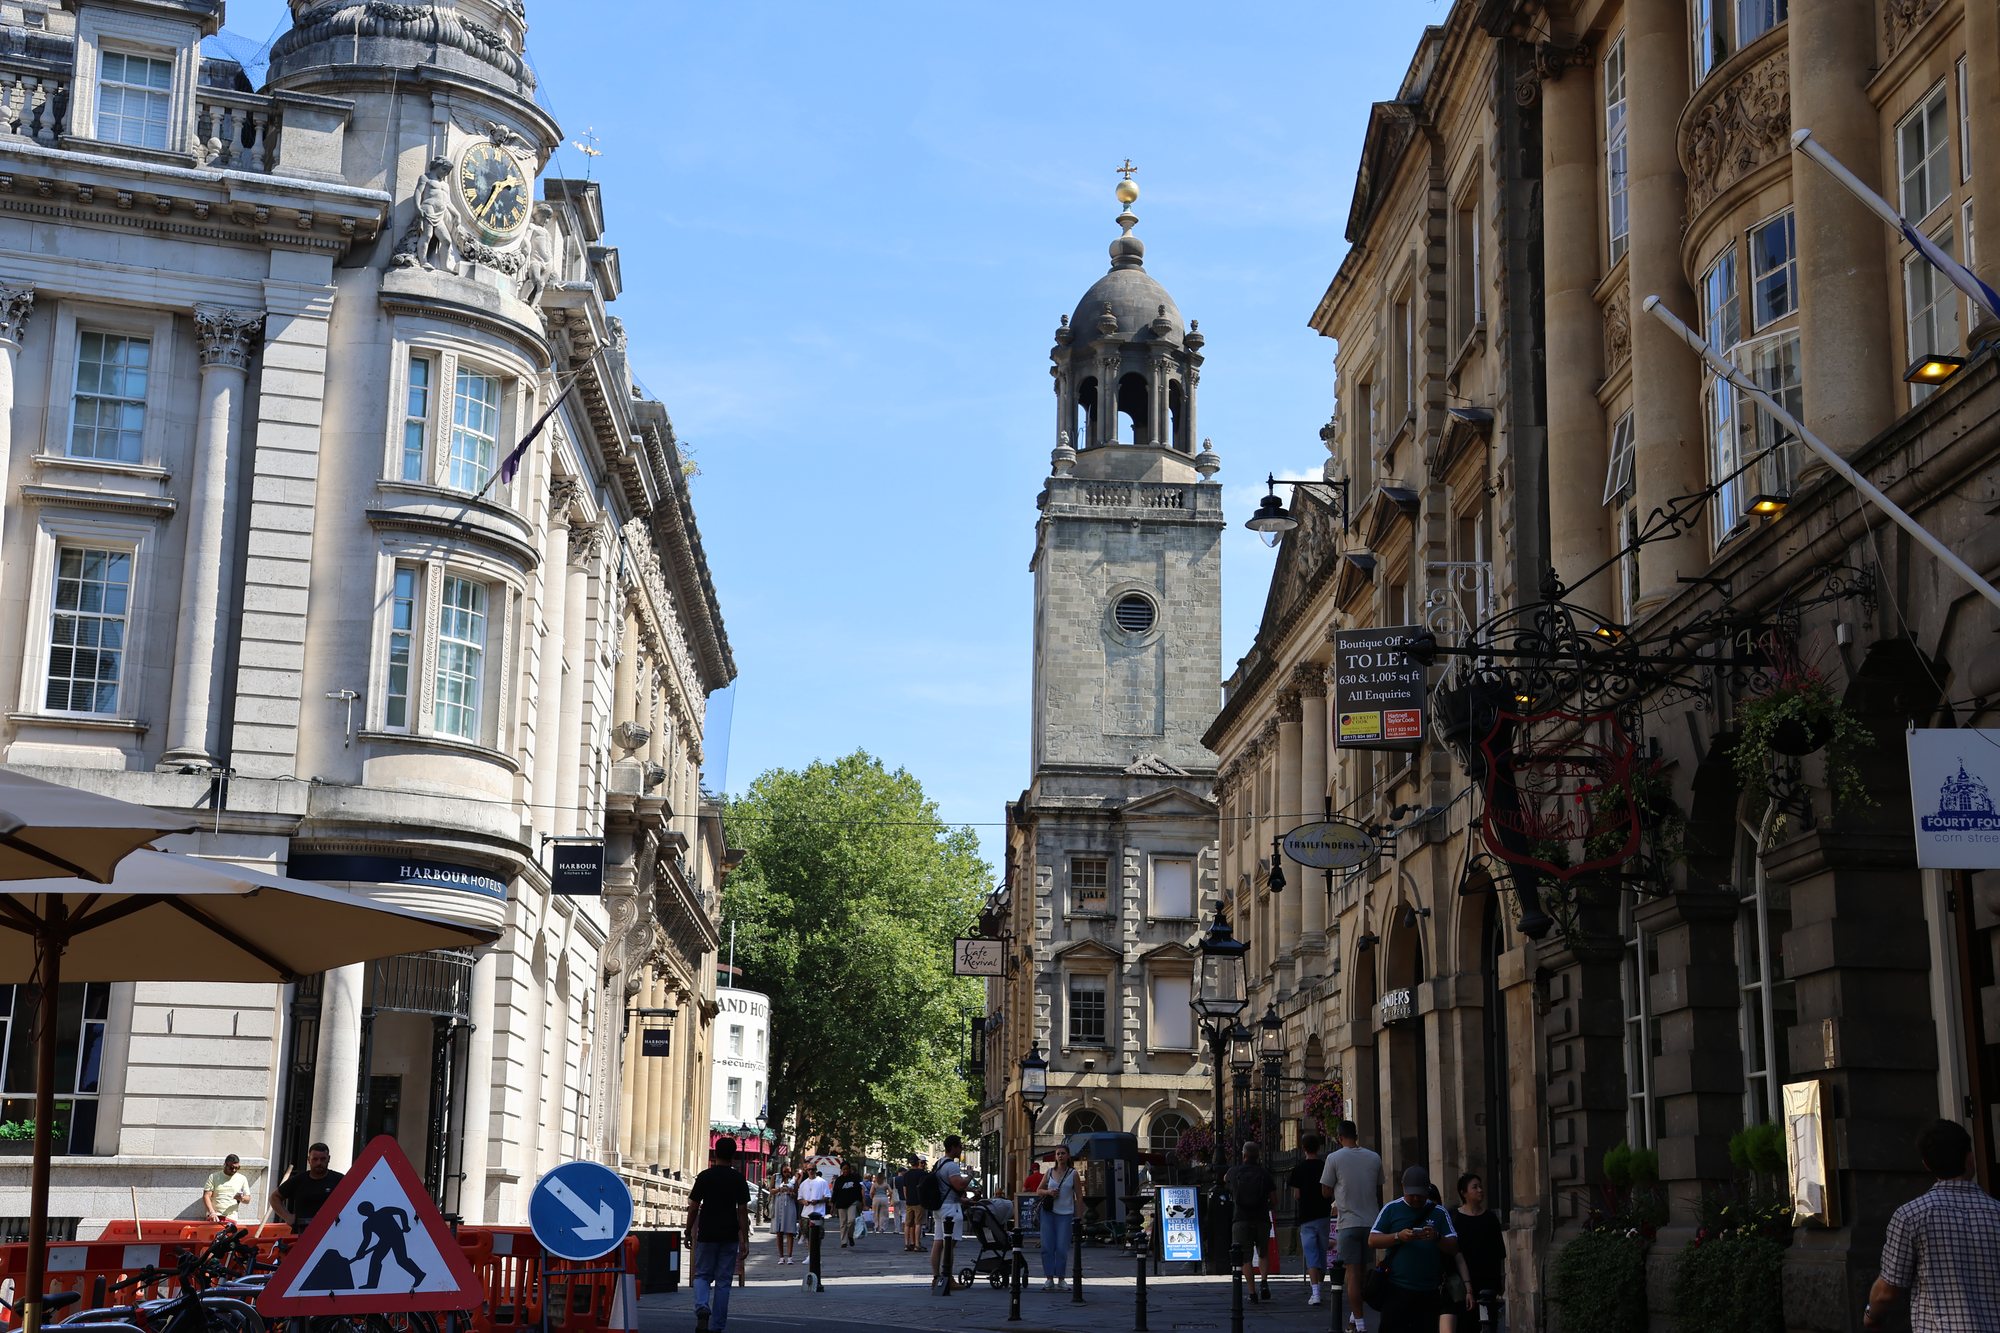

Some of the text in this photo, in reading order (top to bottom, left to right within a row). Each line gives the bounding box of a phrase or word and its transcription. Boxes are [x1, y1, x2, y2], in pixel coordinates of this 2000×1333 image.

[1339, 639, 1383, 651] Boutique
[1345, 651, 1409, 669] TO LET
[1339, 670, 1420, 685] 630 & 1,005 sq ft
[1347, 689, 1411, 702] All Enquiries
[1387, 717, 1401, 725] Taylor
[1927, 817, 2000, 828] FOURTY FOU
[1934, 833, 2000, 843] corn stree
[1289, 841, 1355, 850] TRAILFINDERS
[399, 865, 502, 893] HARBOUR HOTELS
[960, 954, 998, 970] Revival
[717, 997, 768, 1020] AND HOT
[1168, 1223, 1195, 1231] HERE!
